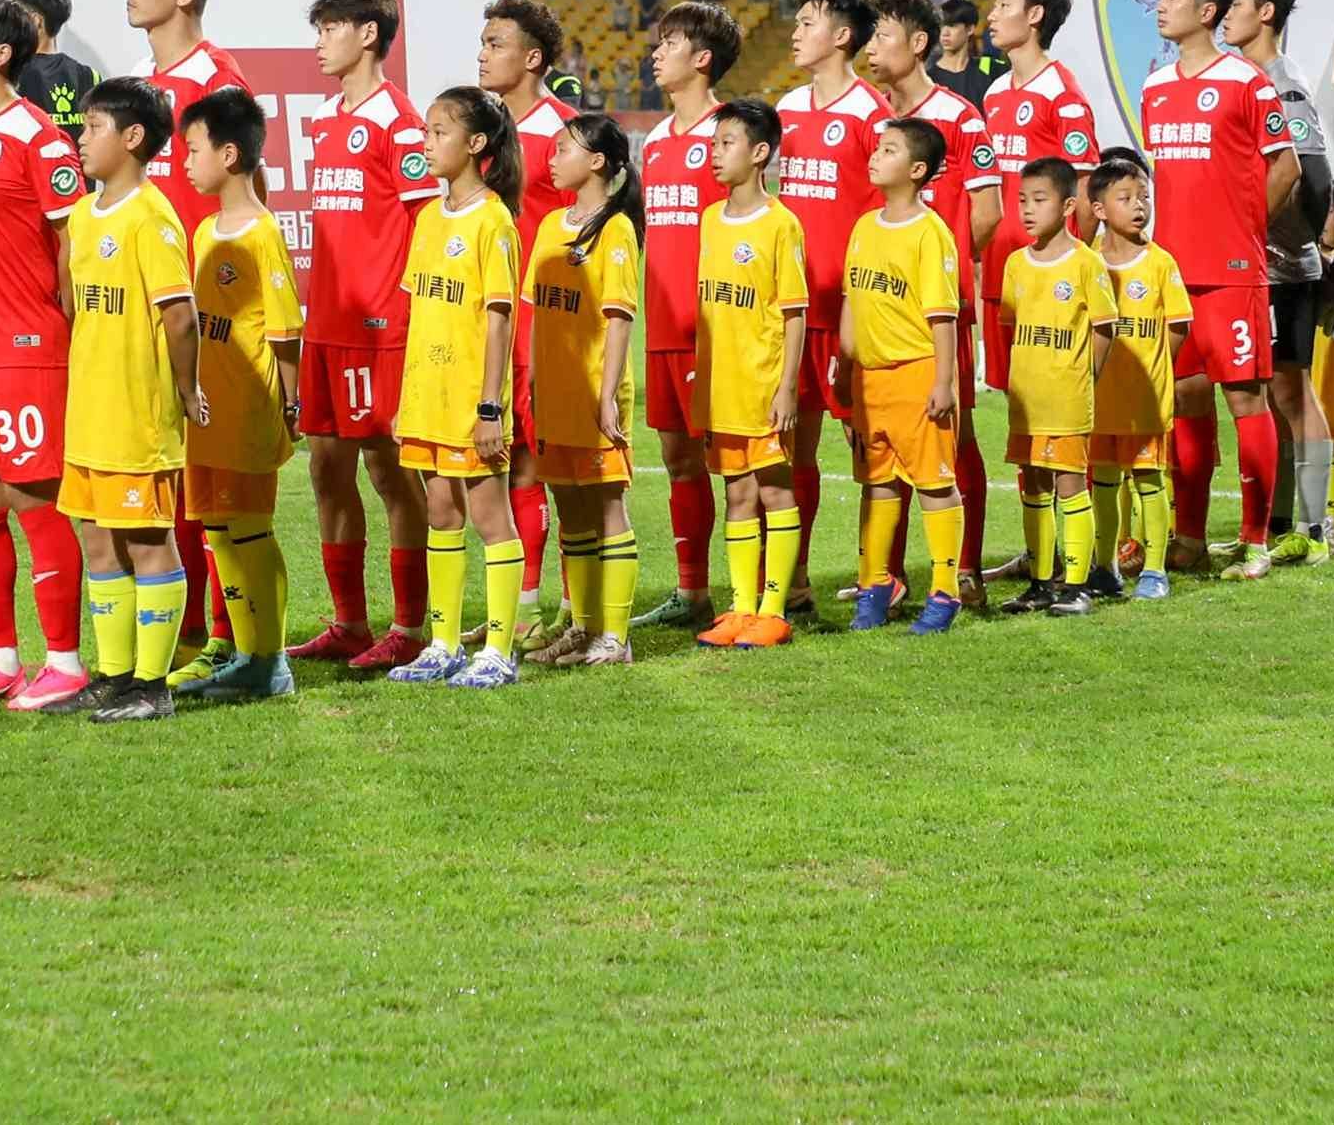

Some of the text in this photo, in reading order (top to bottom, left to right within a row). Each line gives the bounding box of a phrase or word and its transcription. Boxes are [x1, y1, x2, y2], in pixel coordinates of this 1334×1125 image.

[49, 113, 85, 125] ELM
[413, 271, 465, 306] 川青训
[1231, 319, 1253, 355] 3
[344, 367, 373, 408] 11
